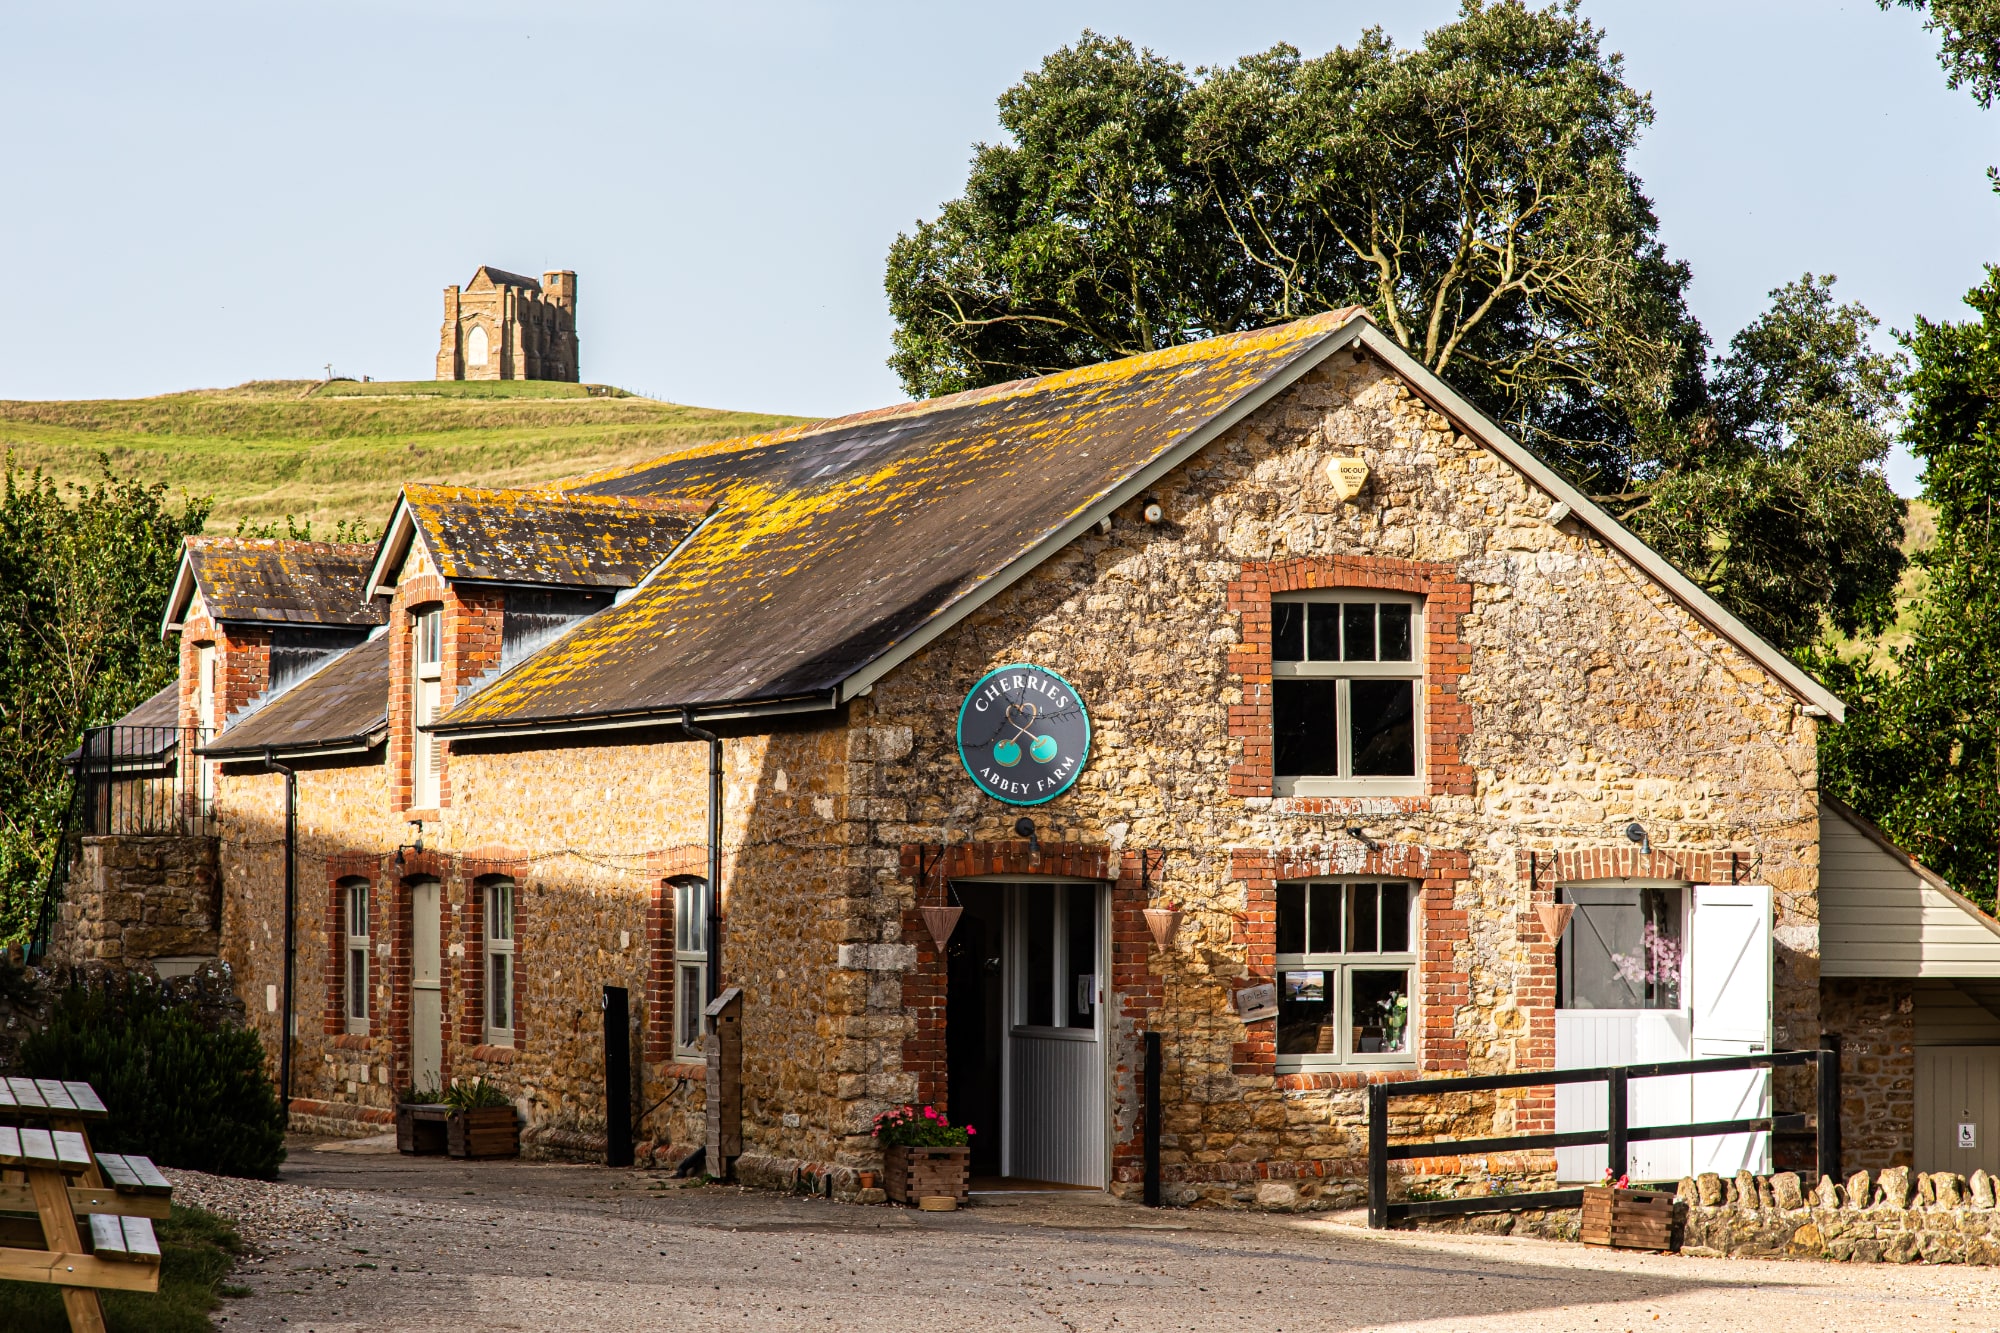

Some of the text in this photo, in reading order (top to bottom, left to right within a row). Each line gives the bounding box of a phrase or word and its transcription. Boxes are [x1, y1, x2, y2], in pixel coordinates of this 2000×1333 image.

[975, 675, 1069, 712] CHERRIES
[980, 756, 1075, 794] ABBEY FARM
[1240, 989, 1269, 1002] Toilets
